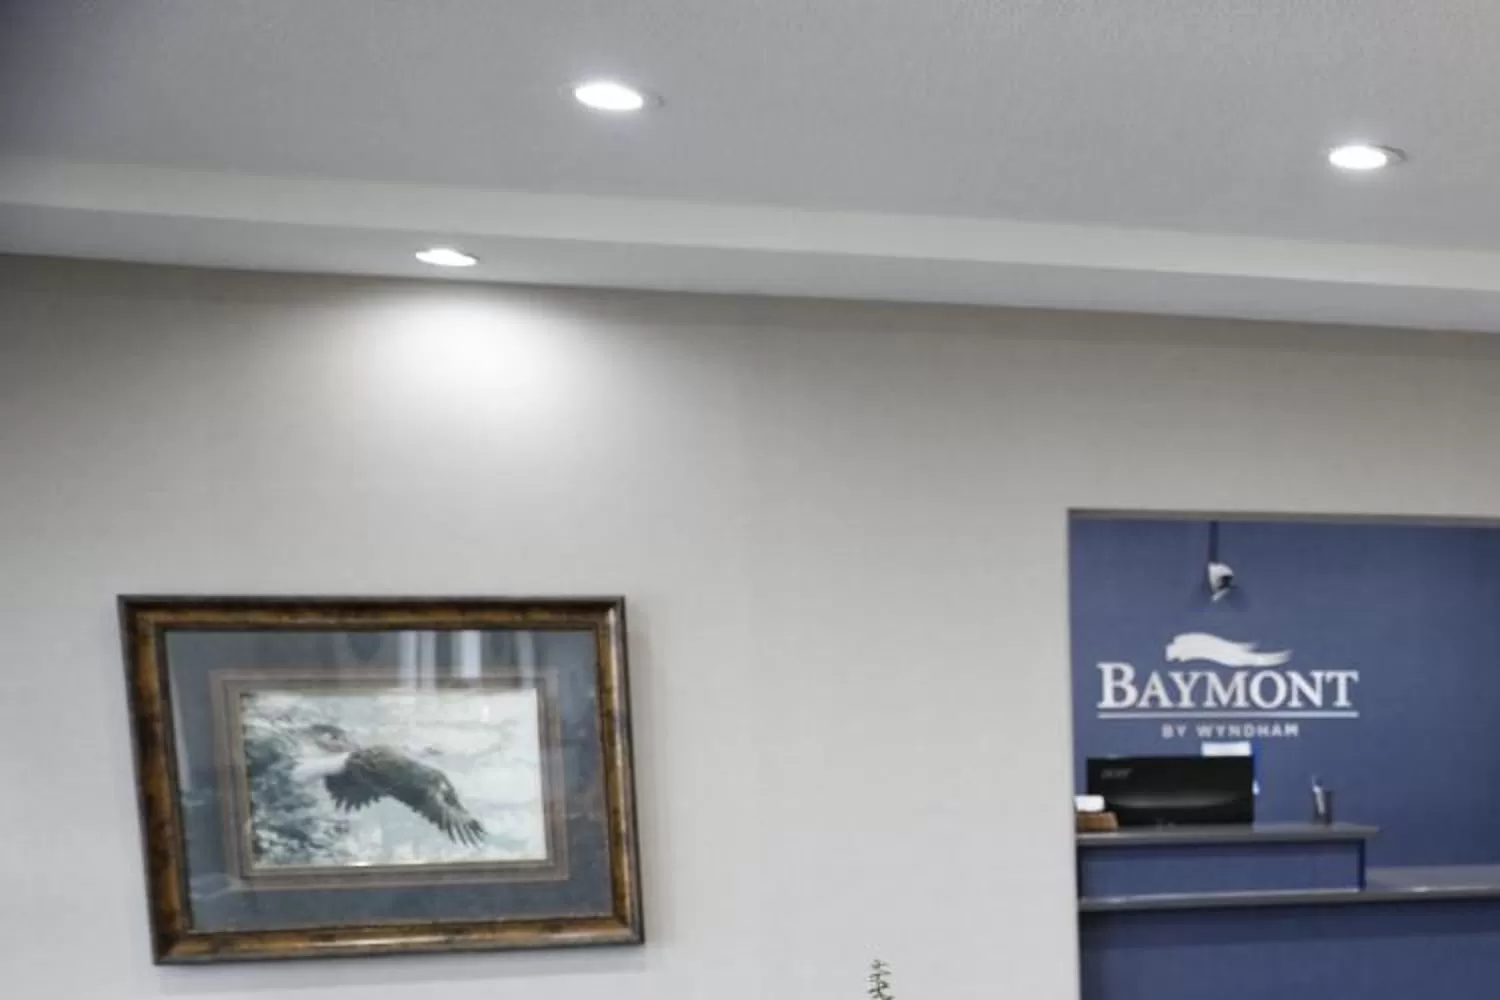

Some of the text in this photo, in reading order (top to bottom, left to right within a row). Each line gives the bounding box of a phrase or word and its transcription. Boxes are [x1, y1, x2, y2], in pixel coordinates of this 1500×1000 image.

[1096, 662, 1359, 709] BAYMONT
[1161, 722, 1299, 738] BY WYNDHAM
